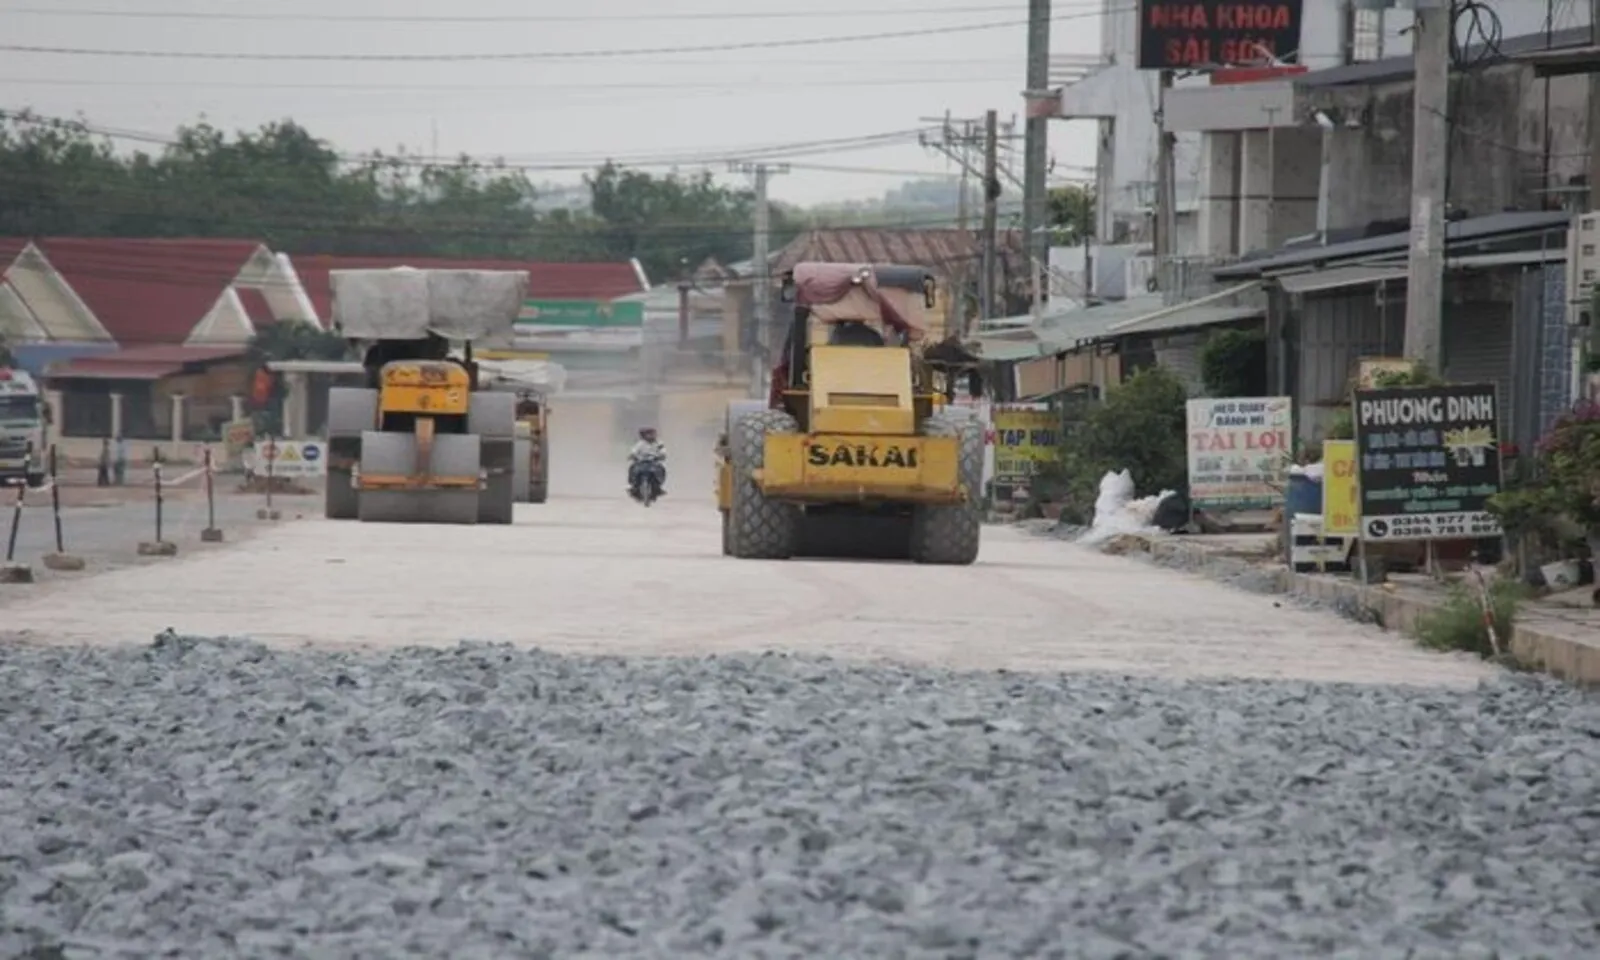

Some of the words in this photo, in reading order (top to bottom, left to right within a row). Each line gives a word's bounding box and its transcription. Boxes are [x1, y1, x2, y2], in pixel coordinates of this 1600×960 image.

[1150, 4, 1208, 29] NHA
[1216, 4, 1289, 29] KHOA
[808, 444, 918, 468] SAKAI
